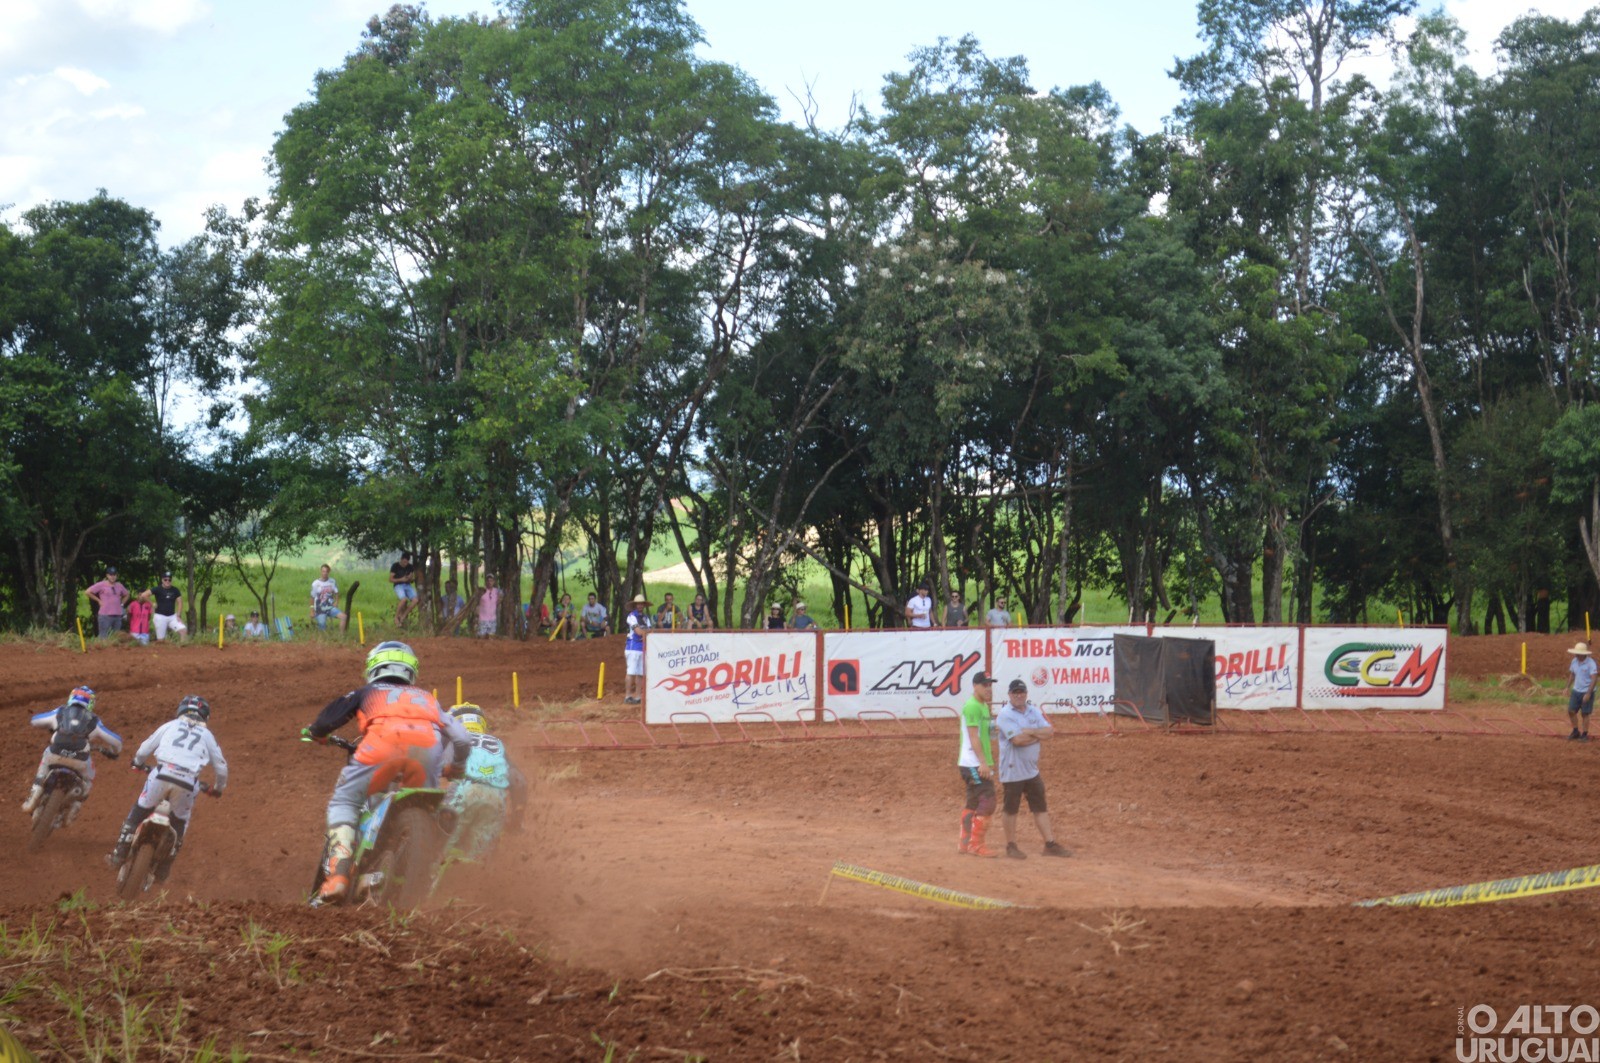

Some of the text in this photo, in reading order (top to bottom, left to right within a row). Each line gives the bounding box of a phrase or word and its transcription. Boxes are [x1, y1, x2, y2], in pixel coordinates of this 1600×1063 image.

[668, 651, 720, 669] OFF ROAD!
[681, 643, 705, 656] VIDA
[1003, 638, 1114, 658] RIBAS Mot
[1215, 644, 1287, 680] ORILLI
[684, 651, 802, 696] BORILLI
[869, 651, 981, 697] AMX
[1051, 667, 1110, 684] YAMAHA
[1224, 665, 1292, 698] Racing
[1324, 642, 1444, 697] CCM
[730, 673, 810, 709] Racing
[172, 727, 202, 752] 27
